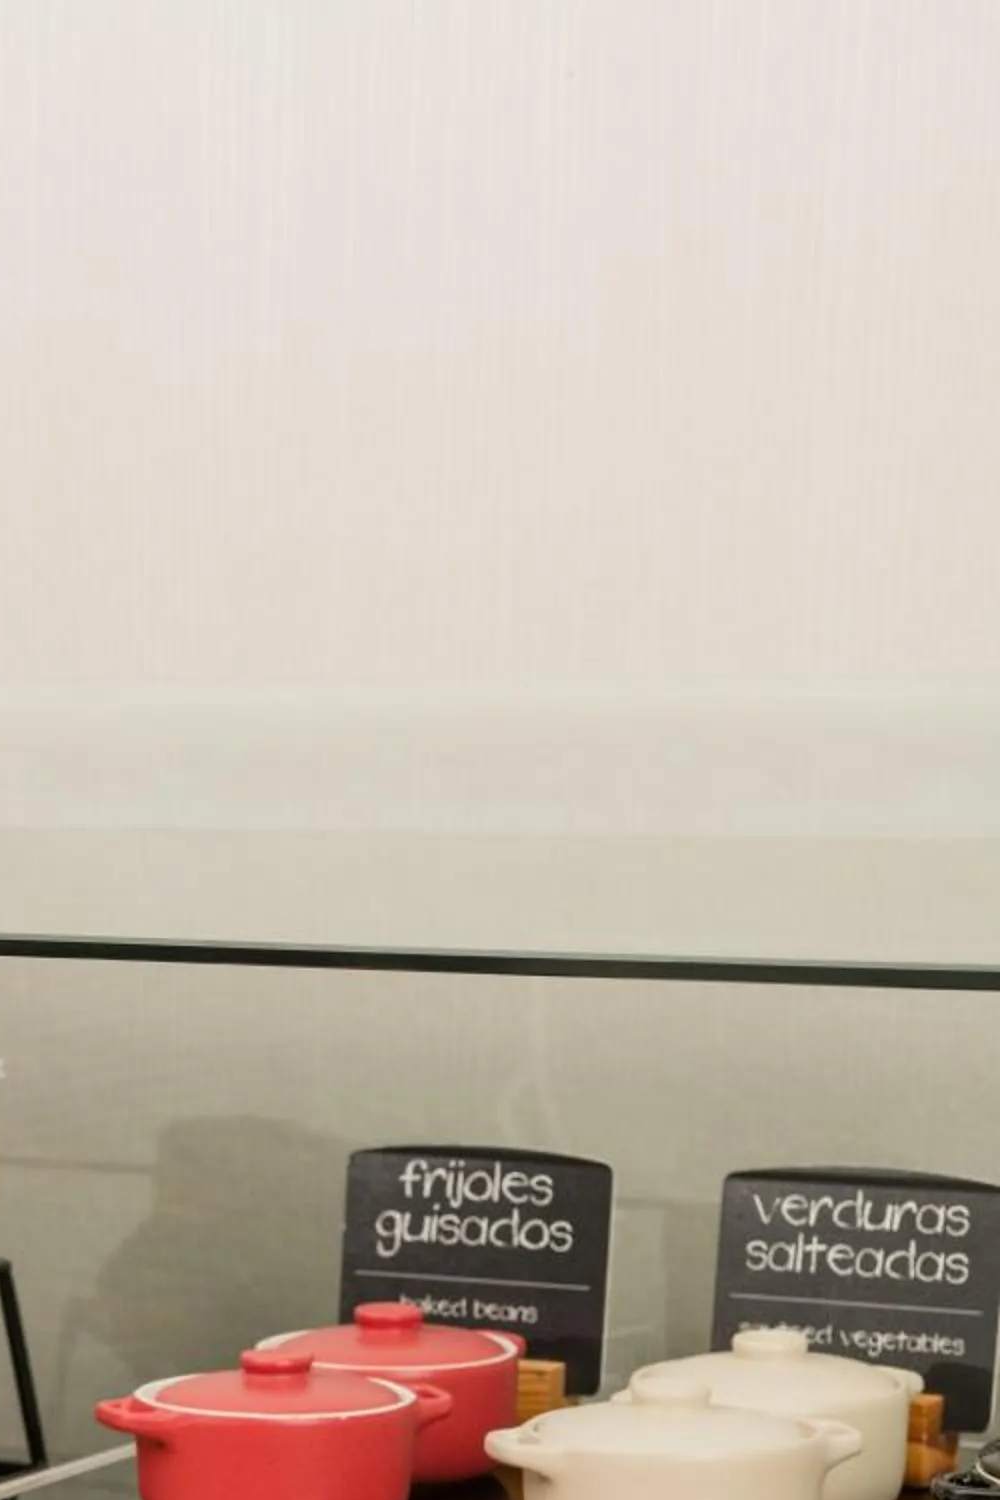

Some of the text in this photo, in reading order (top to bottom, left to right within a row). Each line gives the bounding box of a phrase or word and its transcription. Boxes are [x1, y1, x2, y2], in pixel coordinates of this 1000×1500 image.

[399, 1159, 554, 1209] frijoles
[375, 1203, 574, 1258] guisados
[752, 1188, 971, 1237] verduras
[745, 1231, 970, 1285] salteadas
[399, 1293, 539, 1325] bked beans
[839, 1328, 966, 1357] vegetables
